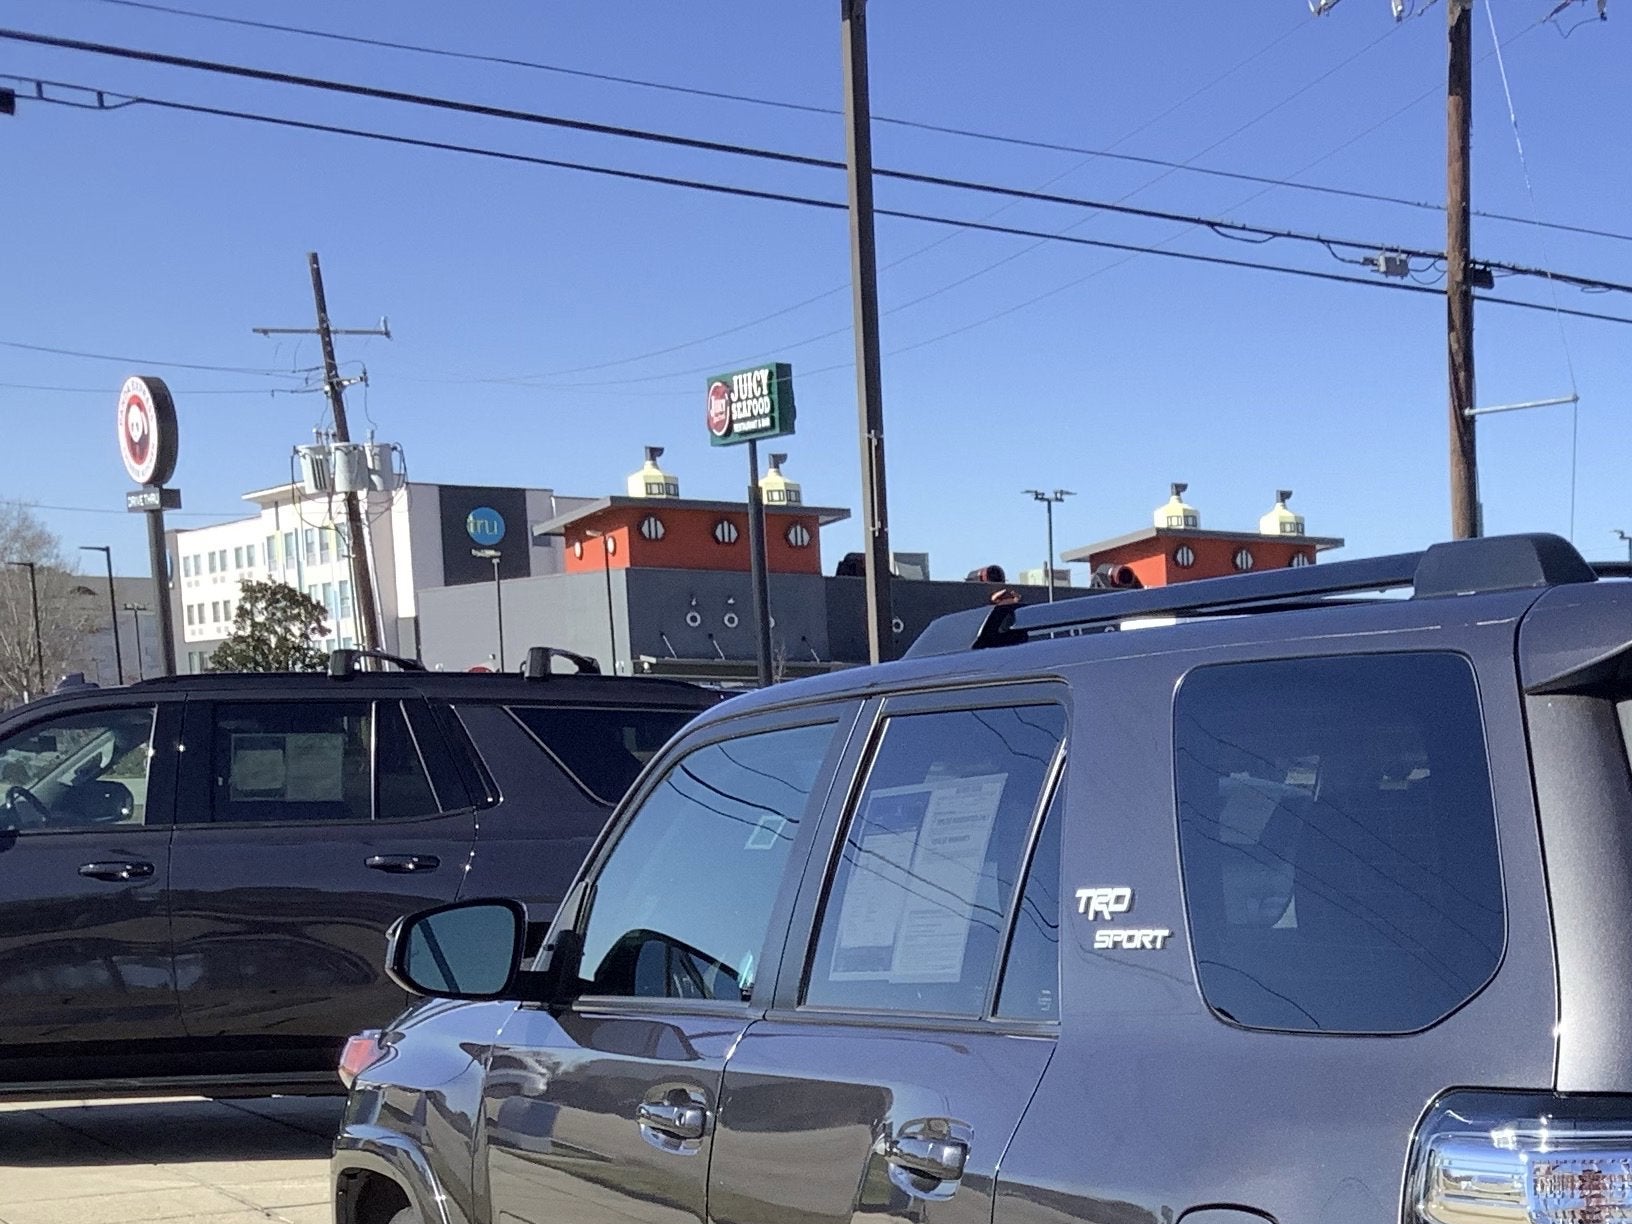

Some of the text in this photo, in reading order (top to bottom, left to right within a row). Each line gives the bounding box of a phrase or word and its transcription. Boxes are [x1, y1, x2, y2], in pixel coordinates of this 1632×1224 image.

[730, 368, 769, 402] JUICY
[731, 396, 771, 420] SEAFOOD
[467, 514, 498, 535] tru
[1075, 887, 1132, 921] TRD
[1093, 929, 1170, 949] SPORT
